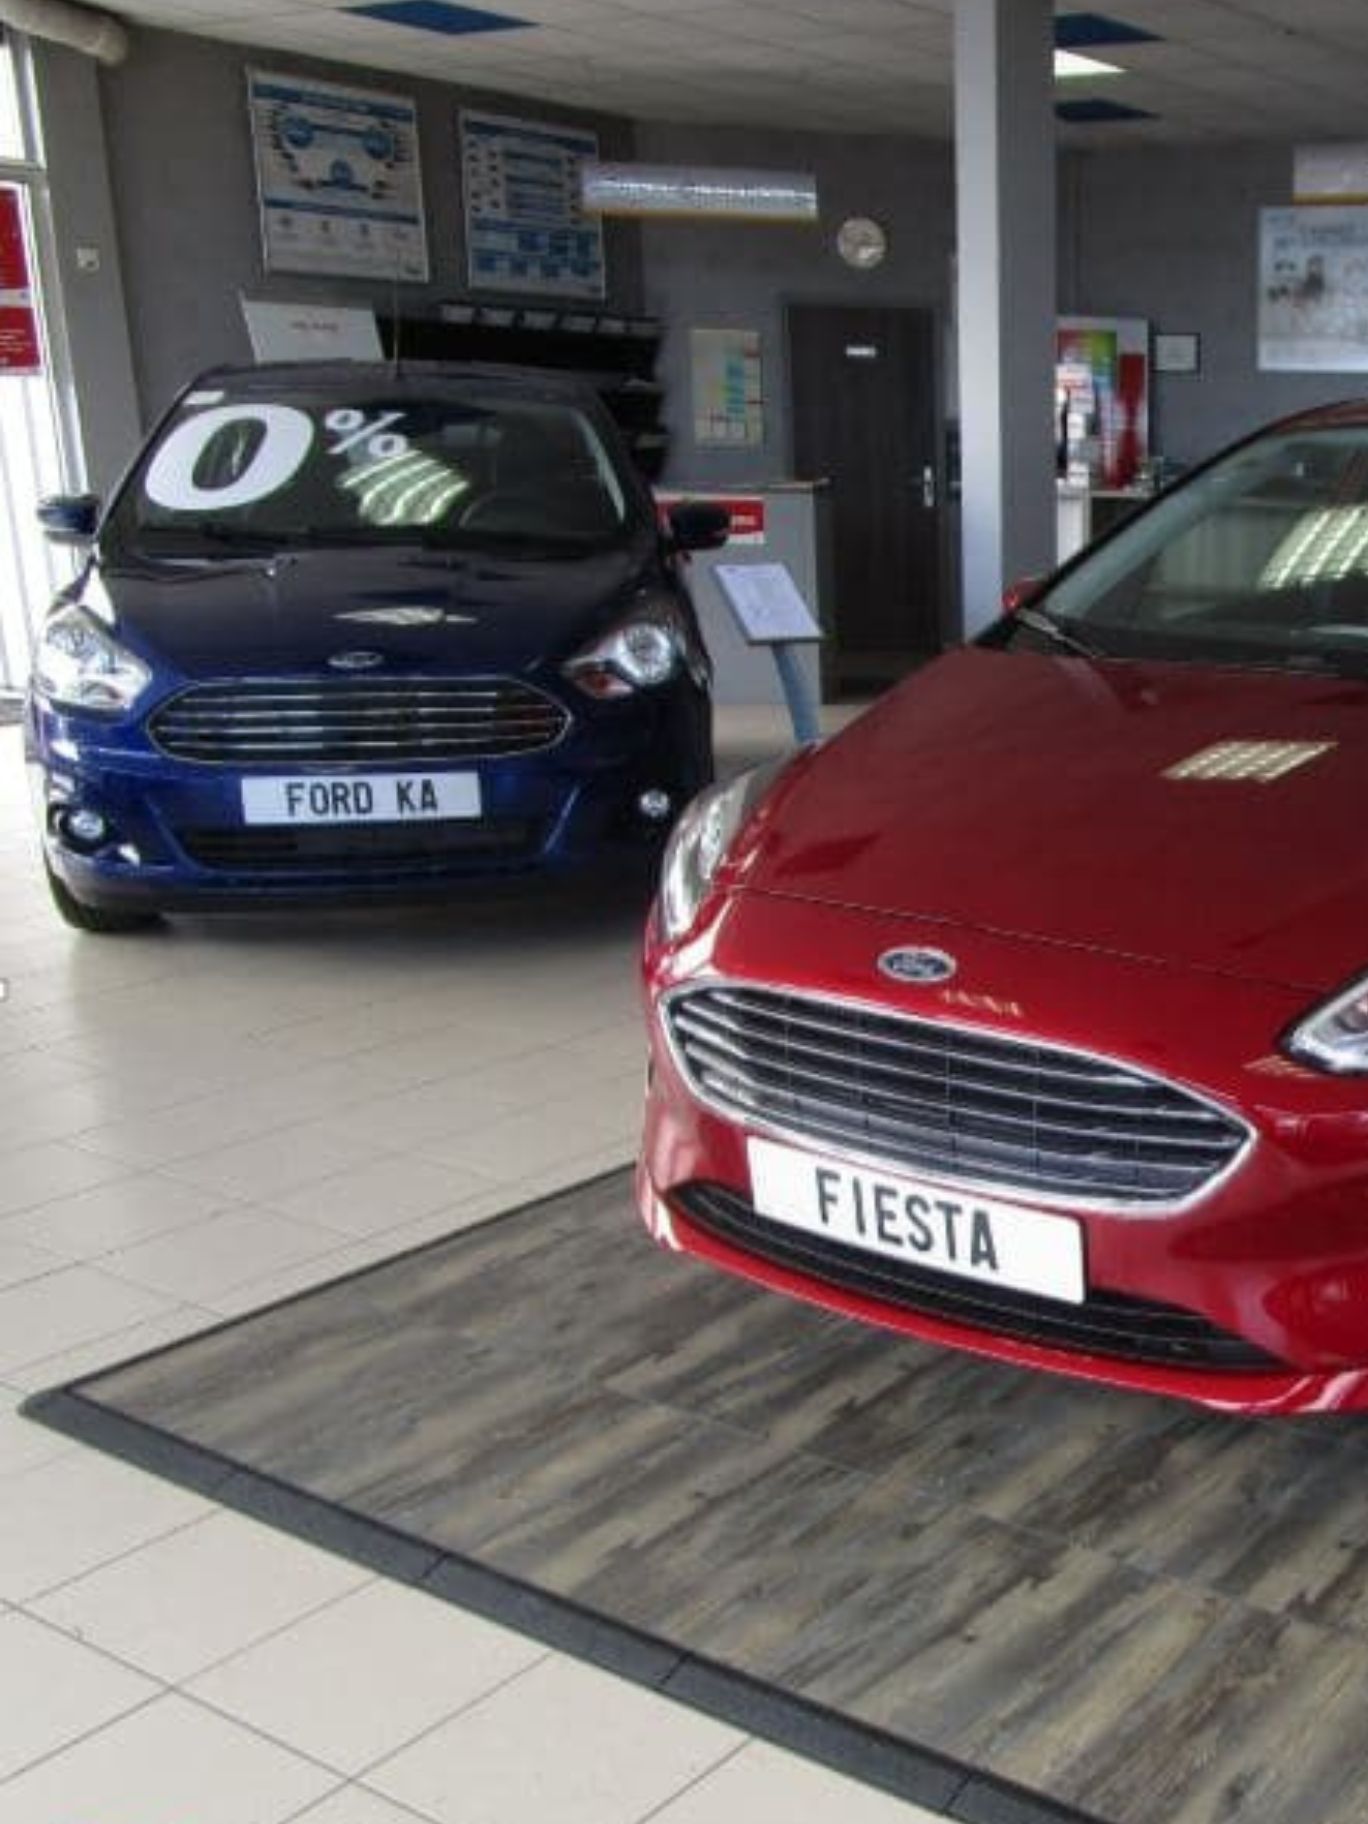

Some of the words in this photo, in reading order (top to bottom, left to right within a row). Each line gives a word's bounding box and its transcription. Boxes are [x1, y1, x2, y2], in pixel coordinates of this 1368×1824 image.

[285, 783, 374, 815] FORD
[396, 780, 439, 813] KA
[814, 1167, 999, 1271] FIESTA
